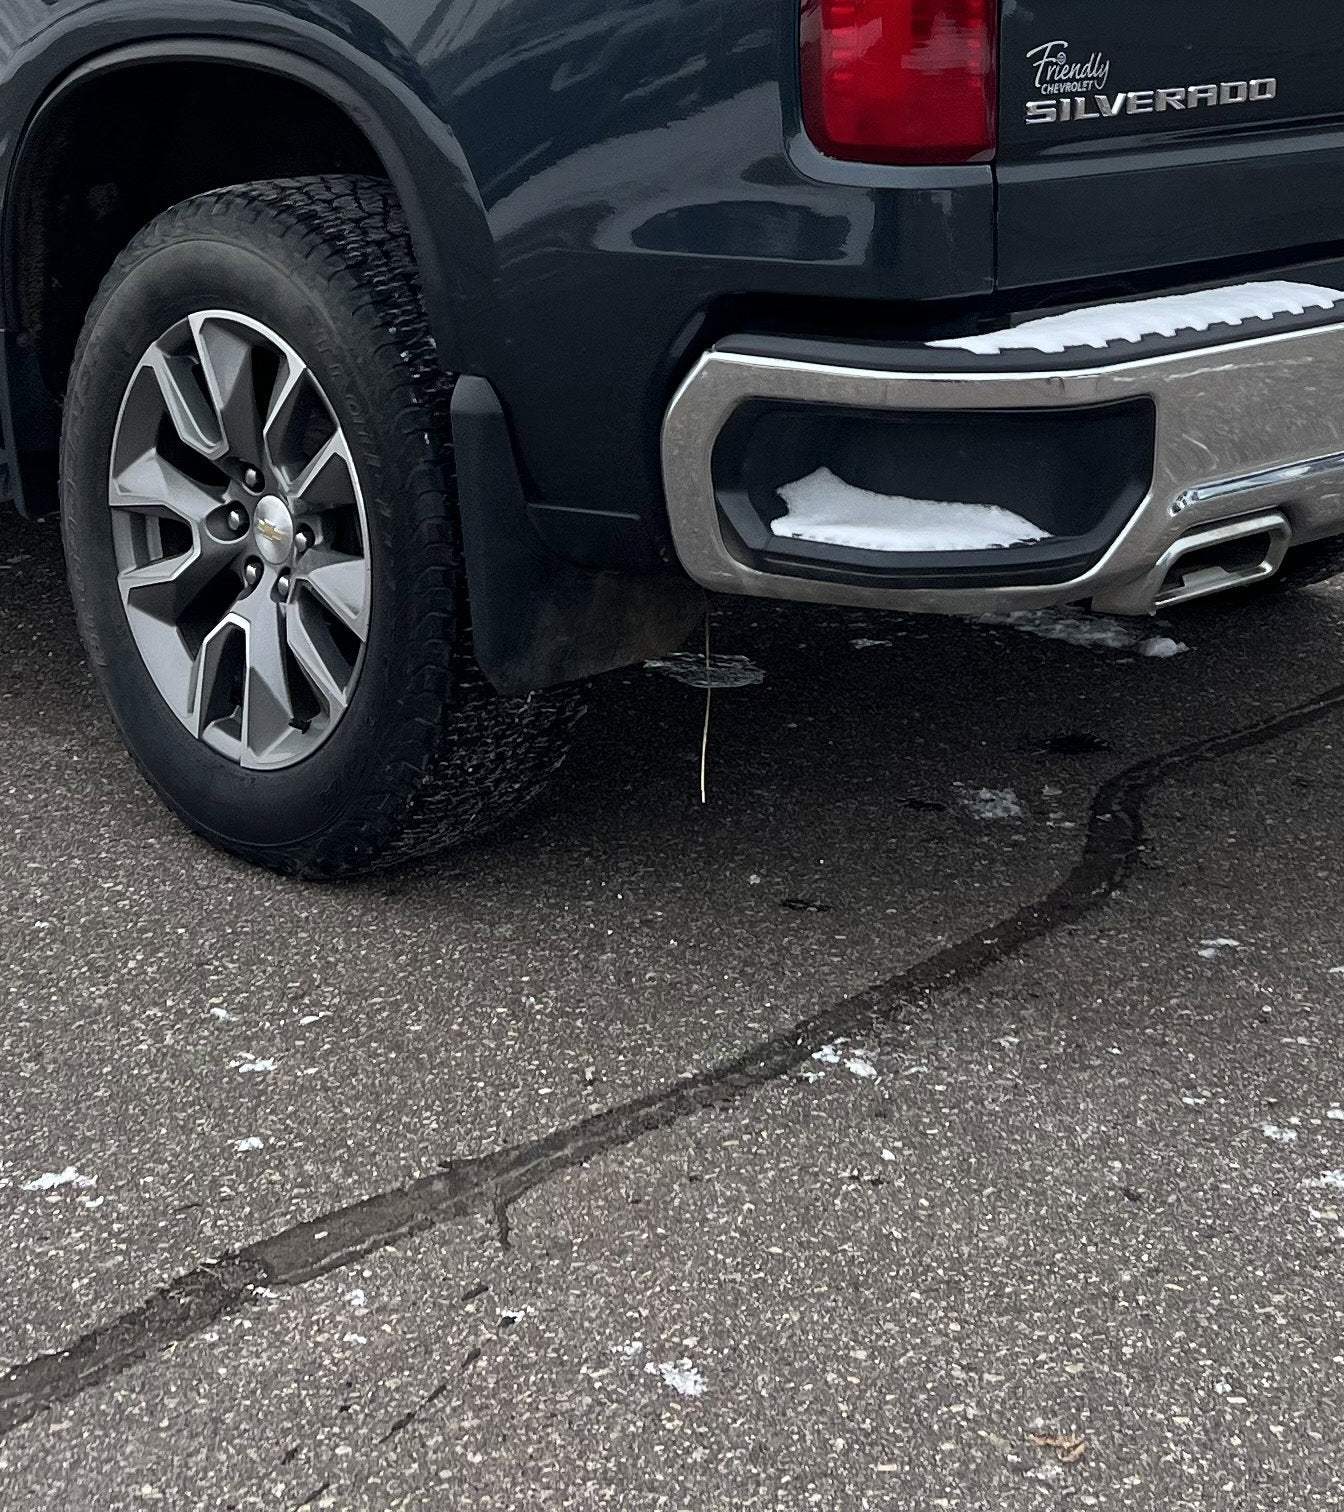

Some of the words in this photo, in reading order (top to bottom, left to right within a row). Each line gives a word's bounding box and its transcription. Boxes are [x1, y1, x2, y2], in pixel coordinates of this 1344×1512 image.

[1025, 39, 1110, 90] Friendly
[1040, 79, 1094, 95] CHEVROLET
[1025, 77, 1276, 125] SILVERADO
